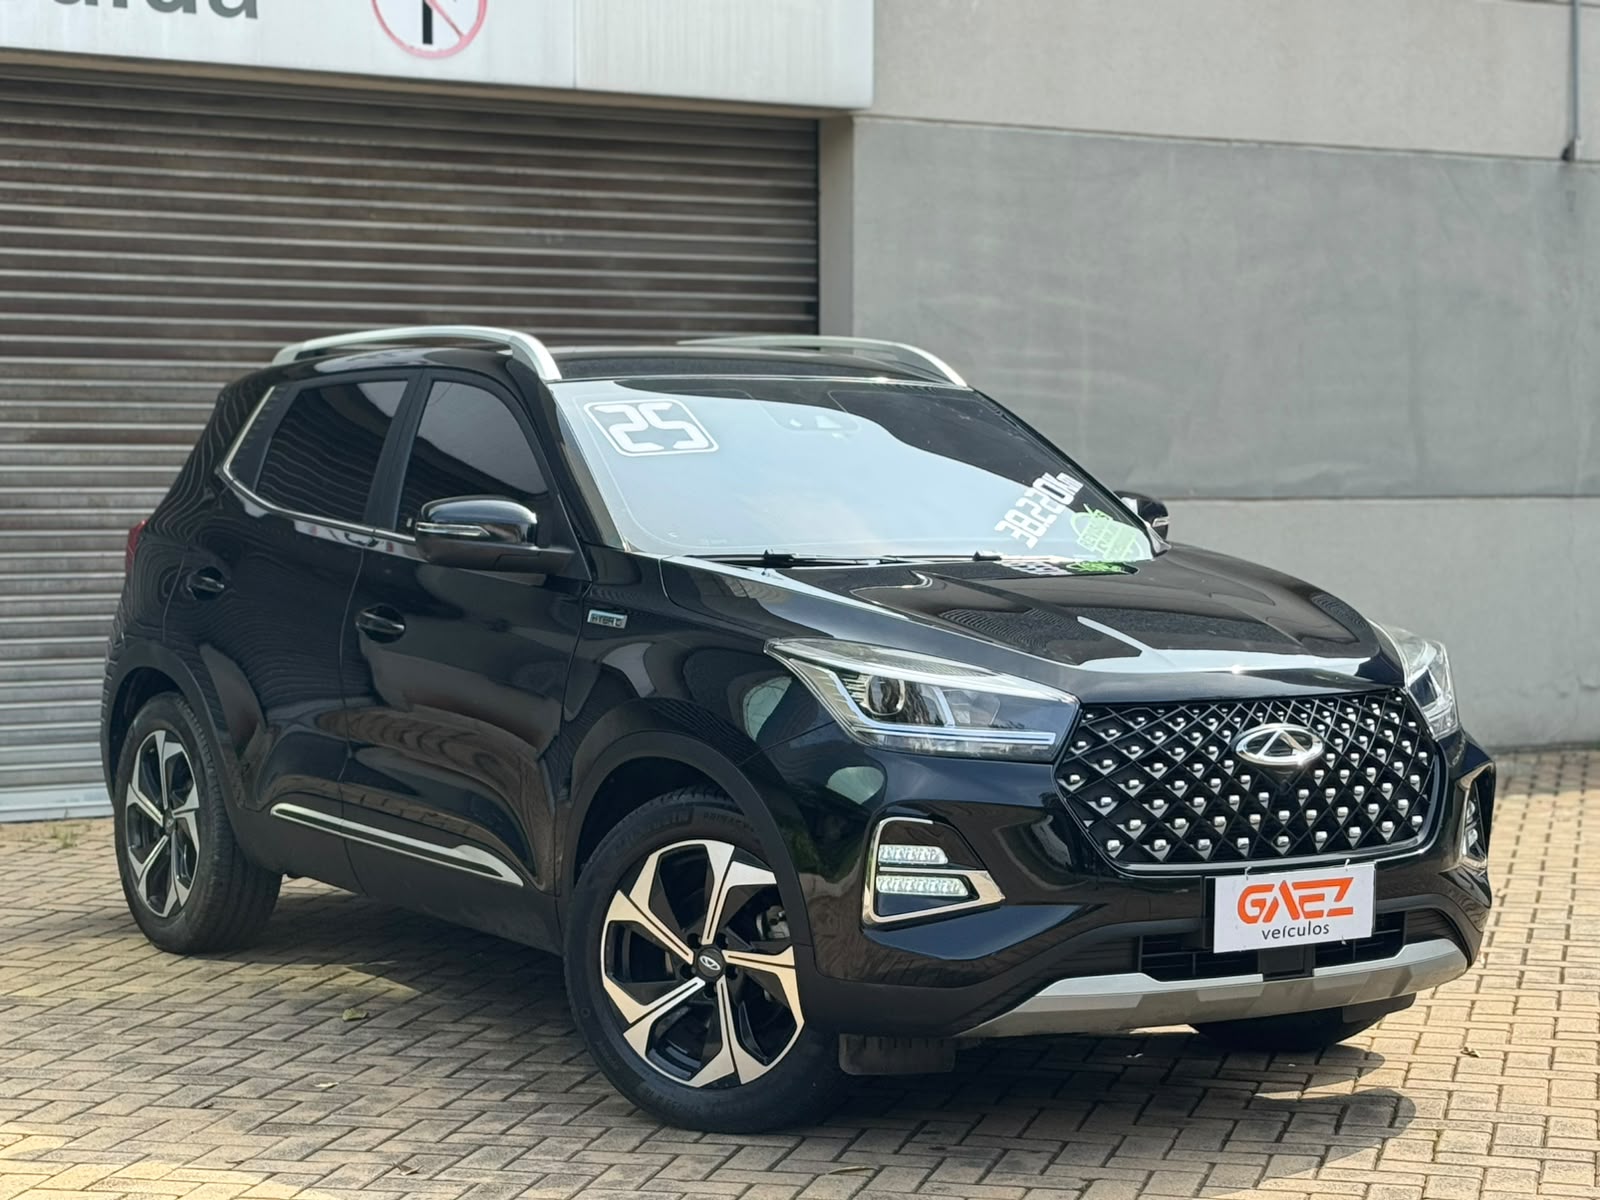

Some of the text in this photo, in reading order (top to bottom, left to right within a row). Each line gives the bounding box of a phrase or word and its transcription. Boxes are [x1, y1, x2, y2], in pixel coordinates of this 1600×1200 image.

[593, 402, 709, 452] 25
[1237, 877, 1354, 924] GAEZ
[1262, 921, 1330, 940] veículos
